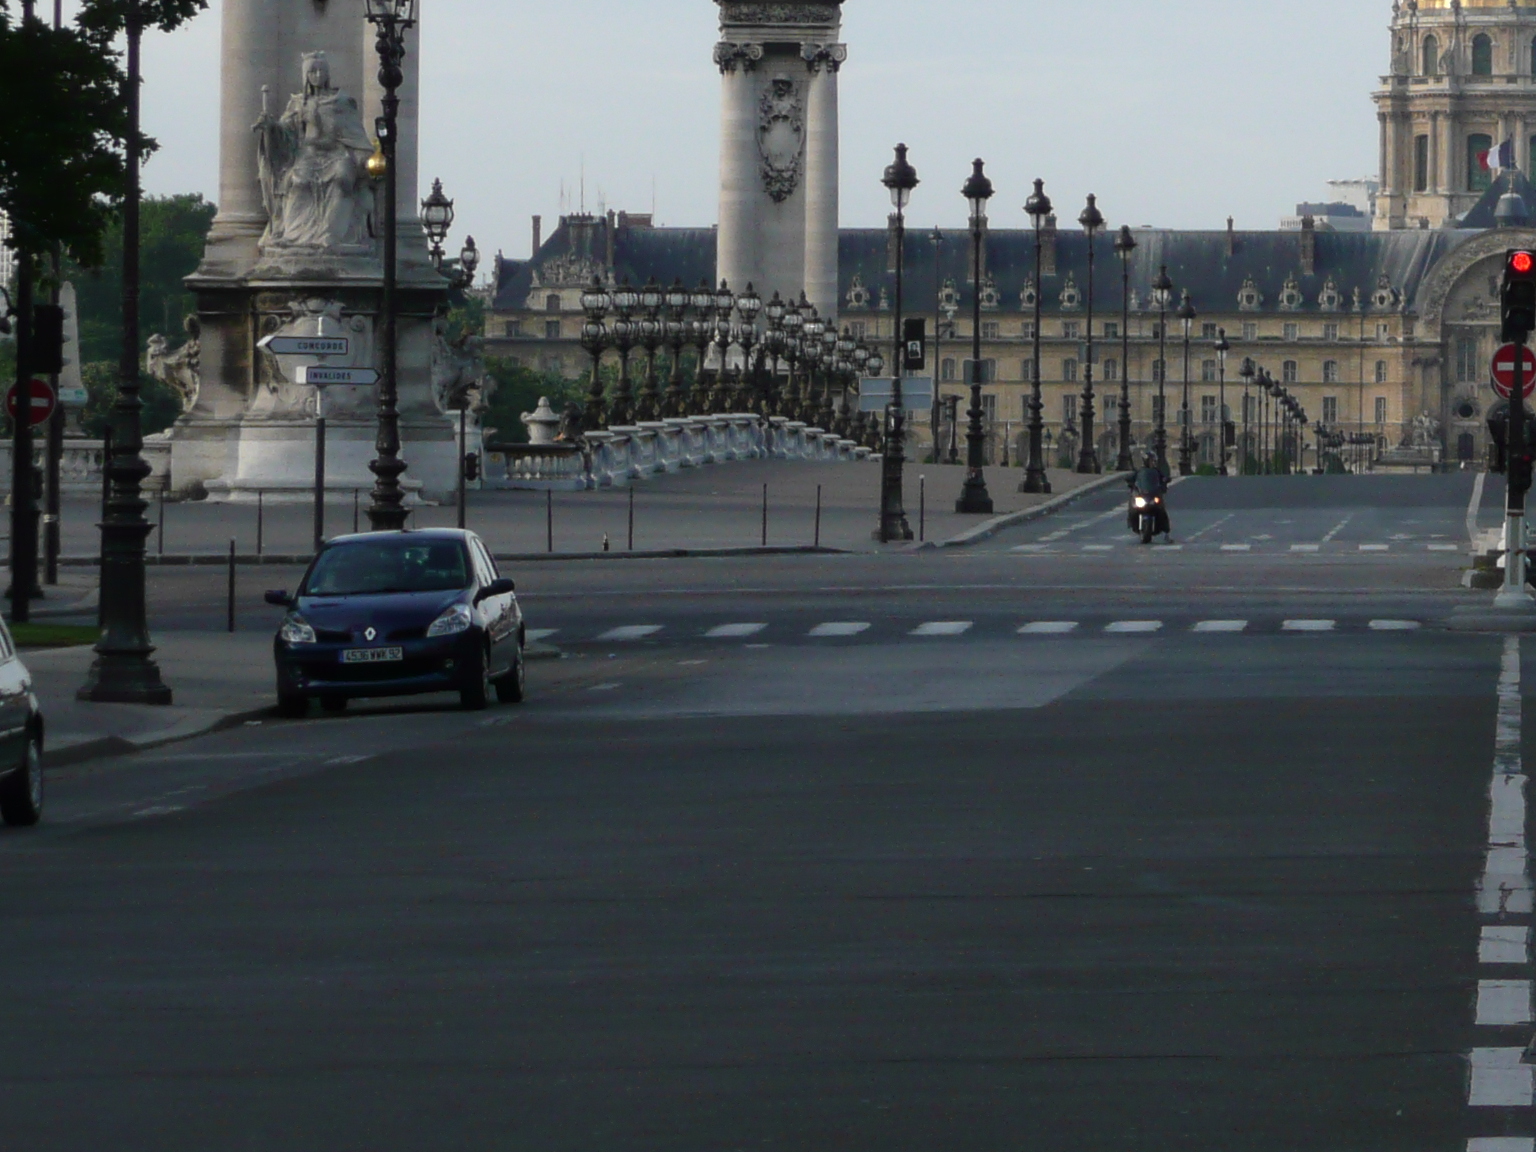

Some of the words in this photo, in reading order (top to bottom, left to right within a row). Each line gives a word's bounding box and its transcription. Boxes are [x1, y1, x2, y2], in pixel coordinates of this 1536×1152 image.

[297, 342, 344, 351] CONCORDE
[309, 371, 352, 381] INVALIDES
[388, 648, 401, 659] 92
